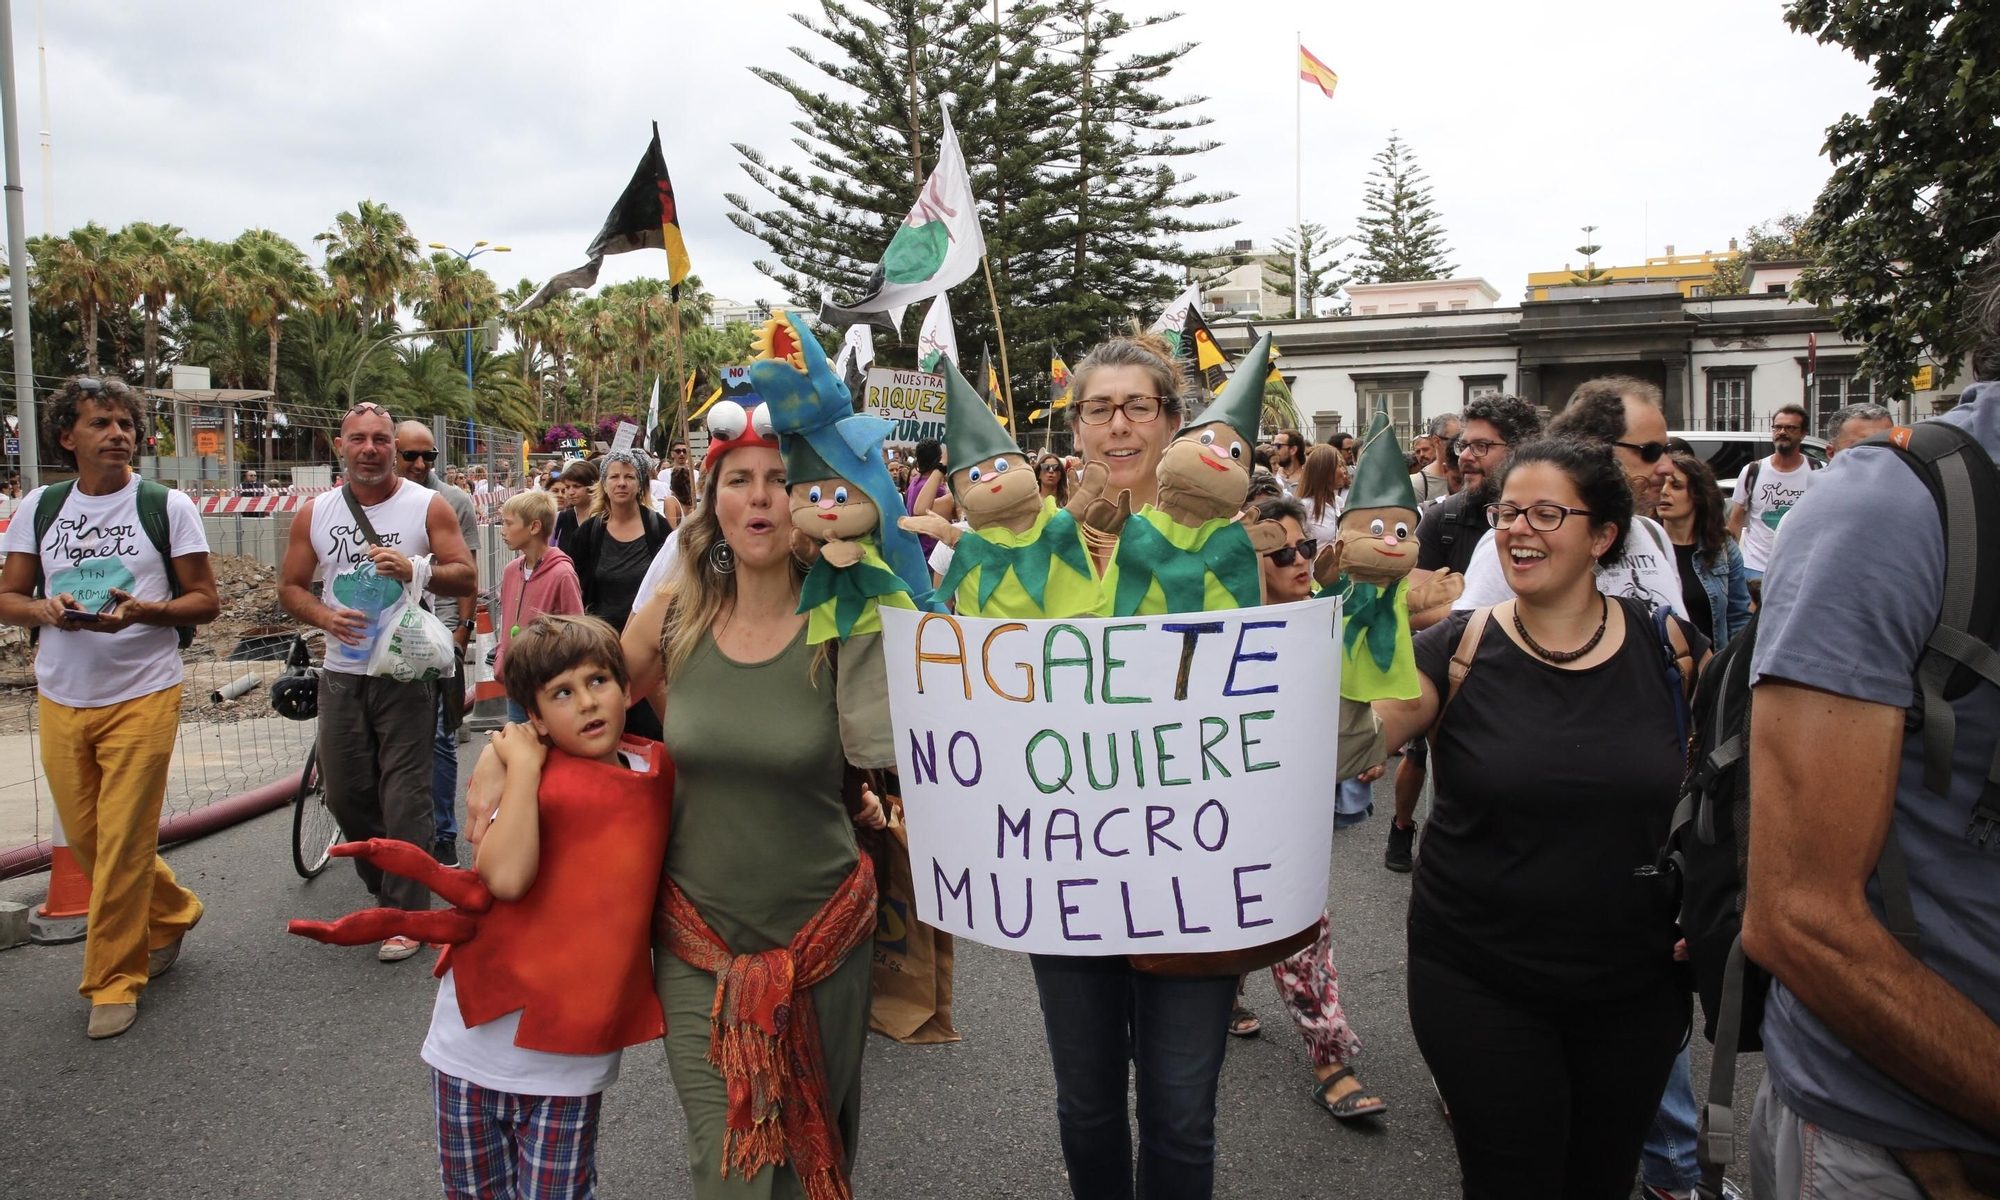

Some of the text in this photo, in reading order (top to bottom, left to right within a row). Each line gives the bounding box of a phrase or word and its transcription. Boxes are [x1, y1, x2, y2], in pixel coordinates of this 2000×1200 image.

[729, 367, 744, 378] NO
[894, 373, 943, 388] NUESTRA
[868, 386, 946, 414] RIQUEZ
[880, 408, 918, 419] ES LA
[560, 439, 587, 448] SALVAR
[54, 533, 139, 567] Agaete
[328, 523, 401, 556] Salar
[916, 613, 1287, 704] AGAETE
[909, 710, 1281, 794] NO QUIERE
[997, 799, 1229, 861] MACRO
[932, 856, 1274, 941] MUELLE
